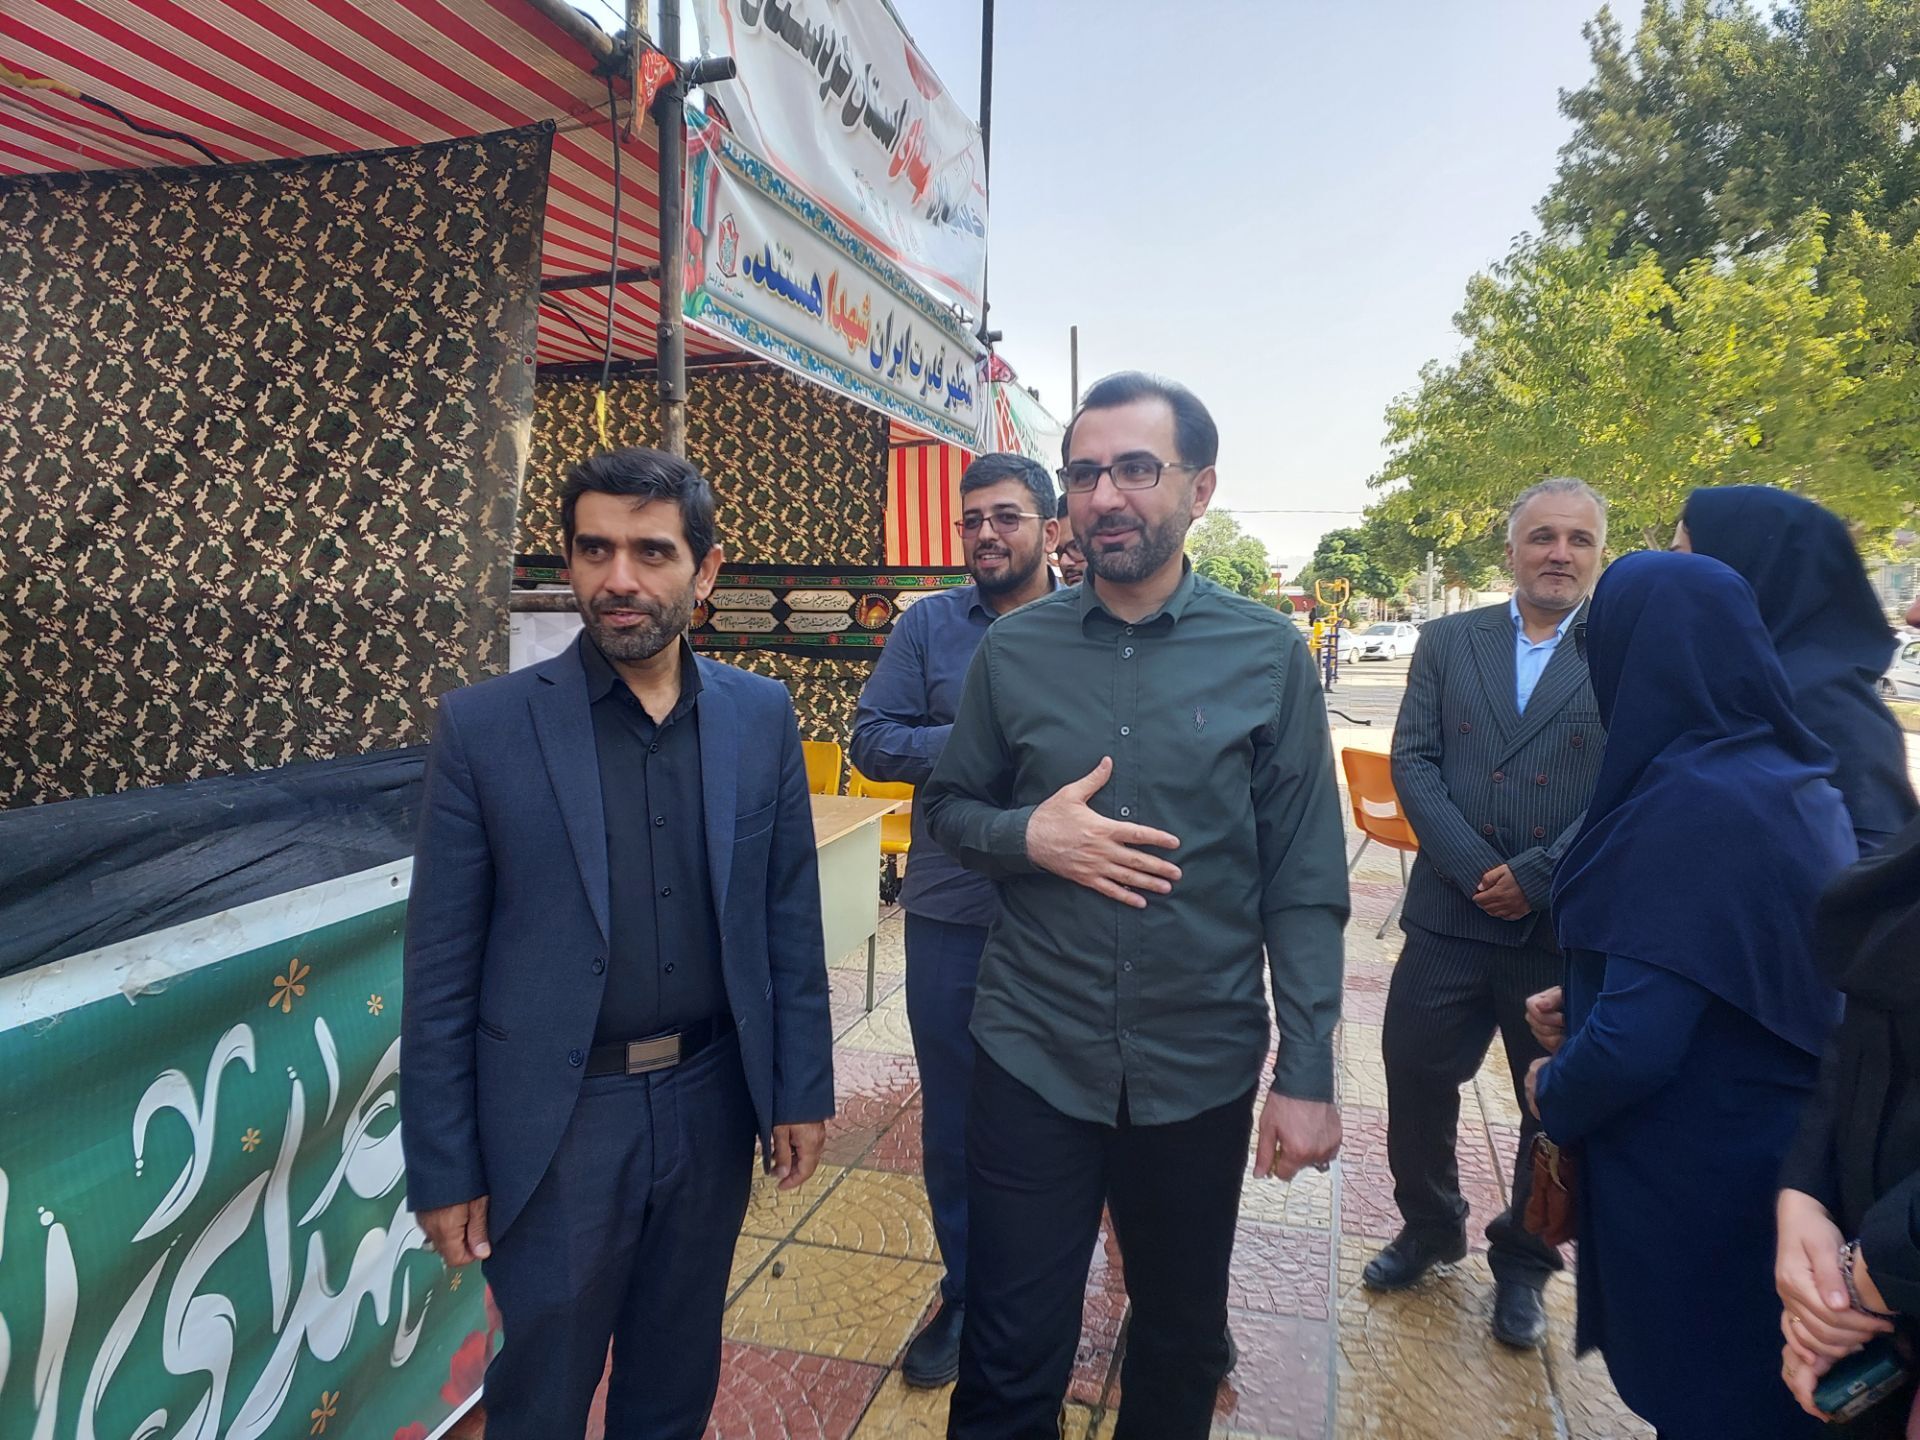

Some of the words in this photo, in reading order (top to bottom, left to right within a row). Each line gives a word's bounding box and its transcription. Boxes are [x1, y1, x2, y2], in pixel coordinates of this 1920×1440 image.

[841, 62, 908, 154] استان
[826, 270, 871, 351] شهدا
[870, 308, 912, 381] ایران
[909, 341, 944, 397] قدرت
[944, 358, 973, 409] مظهر
